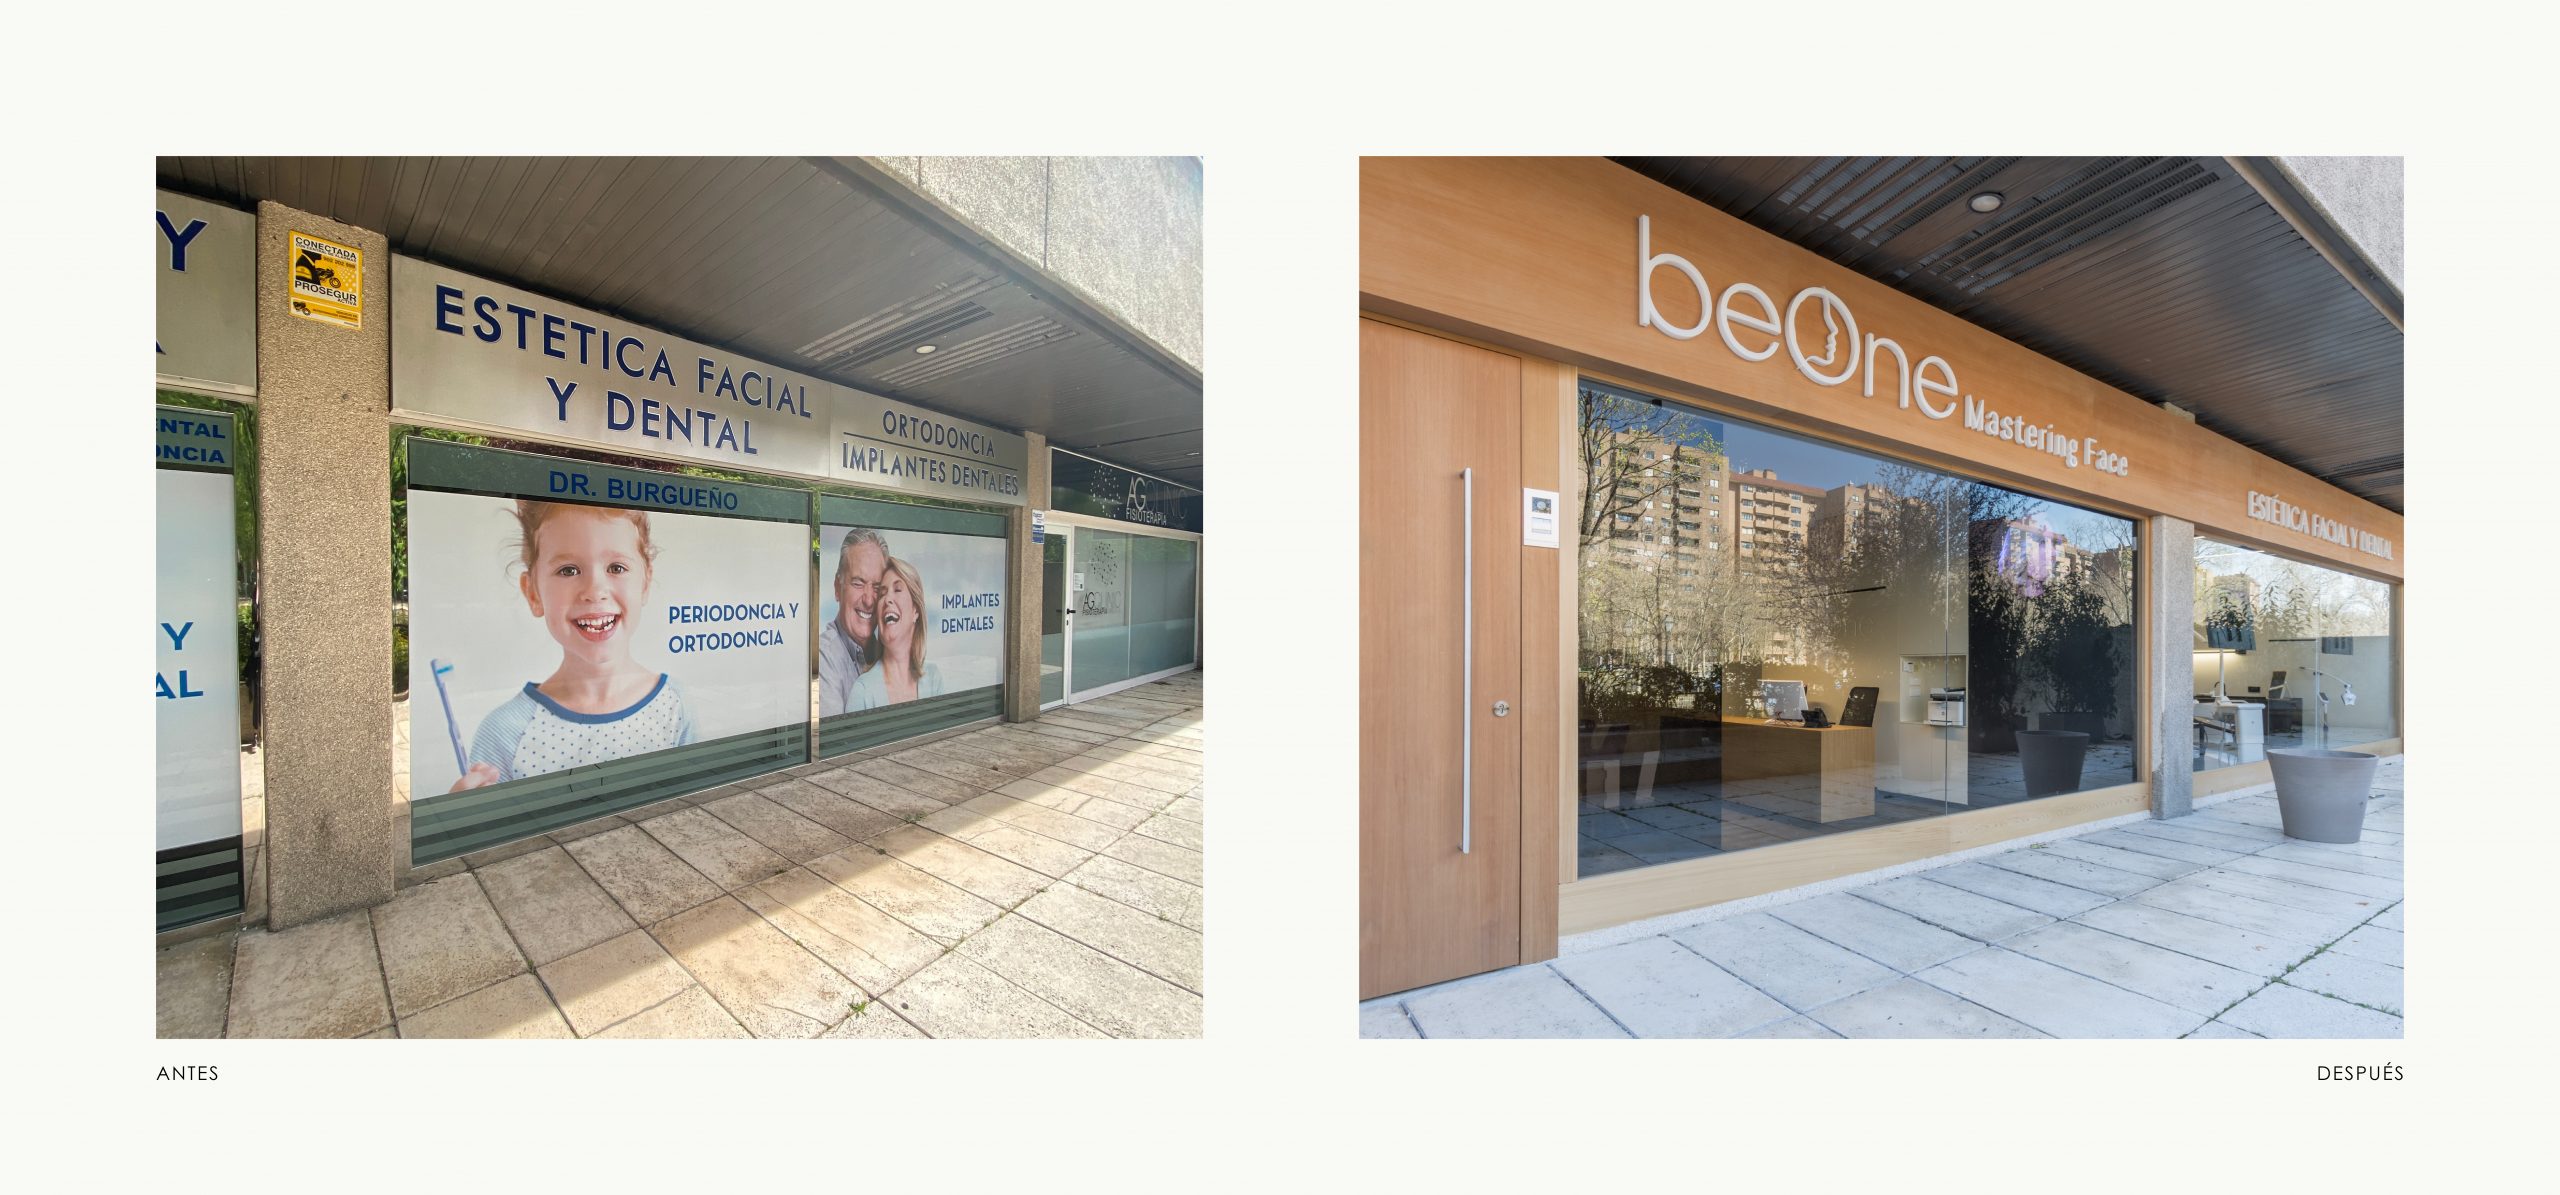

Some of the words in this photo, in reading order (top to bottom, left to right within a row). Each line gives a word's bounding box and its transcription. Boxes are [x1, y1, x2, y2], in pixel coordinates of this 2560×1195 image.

[156, 210, 209, 272] Y
[295, 236, 357, 260] CONECTADA
[294, 280, 357, 302] PROSEGUR
[337, 298, 357, 307] ACTIVA
[1639, 214, 1959, 420] beOne
[435, 284, 677, 387] ESTETICA
[697, 357, 813, 419] FACIAL
[156, 418, 226, 439] NTAL
[545, 376, 578, 422] Y
[607, 390, 758, 455] DENTAL
[883, 410, 995, 459] ORTODONCIA
[1964, 394, 2079, 469] Mastering
[2083, 437, 2129, 477] Face
[842, 441, 946, 484] IMPLANTES
[952, 463, 1019, 497] DENTALES
[550, 470, 597, 497] DR.
[607, 477, 738, 511] BURGUEÑO
[2247, 490, 2310, 535] ESTÉTICA
[2311, 513, 2350, 548] FACIAL
[2350, 526, 2359, 549] Y
[2359, 530, 2394, 561] DENTAL
[669, 603, 786, 624] PERIODONCIA
[789, 603, 799, 618] Y
[942, 593, 1000, 609] IMPLANTES
[160, 621, 194, 651] Y
[668, 629, 784, 654] ORTODONCIA
[941, 615, 994, 634] DENTALES
